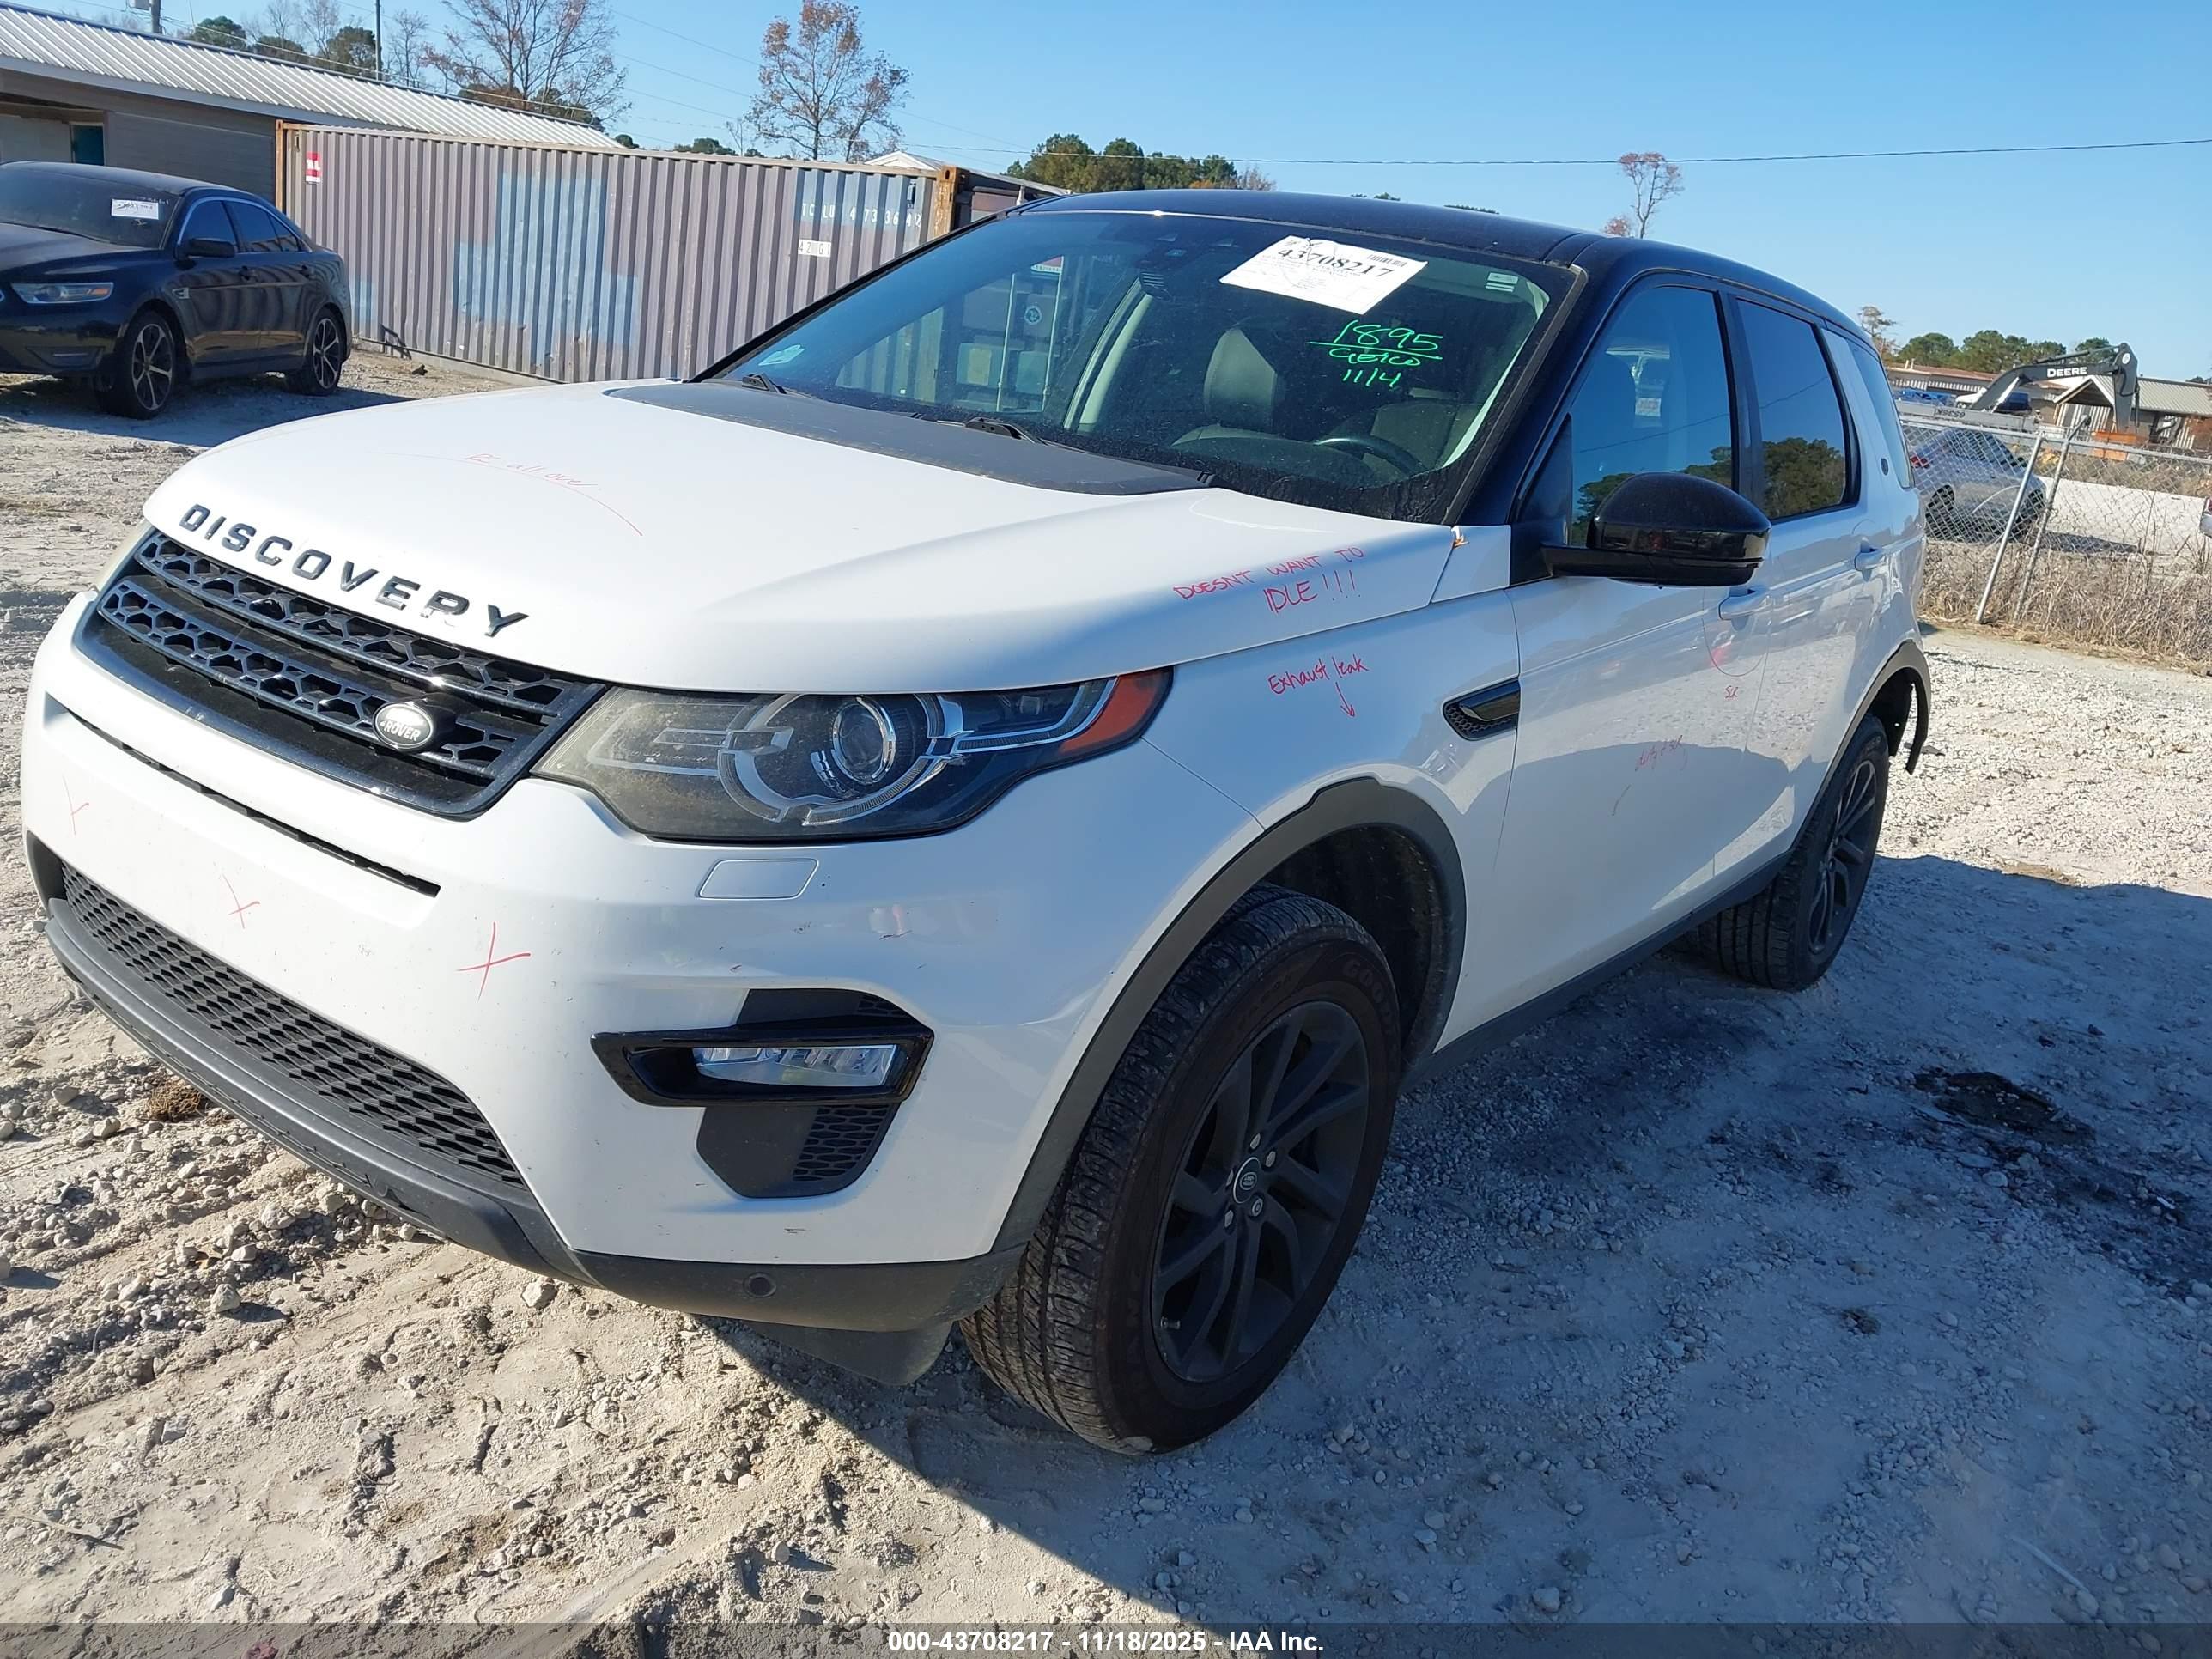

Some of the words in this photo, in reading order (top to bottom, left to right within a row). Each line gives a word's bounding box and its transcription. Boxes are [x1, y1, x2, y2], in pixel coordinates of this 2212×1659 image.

[1278, 248, 1393, 277] 43708217
[1333, 319, 1443, 351] 1895
[1342, 368, 1401, 387] 11/4
[2046, 366, 2087, 378] DEERE
[178, 503, 529, 638] DISCOVERY
[1265, 556, 1322, 575] WANT
[1334, 547, 1364, 562] TO
[1267, 658, 1330, 694] Exhaust
[1331, 653, 1370, 678] leak
[383, 720, 421, 741] ROVER
